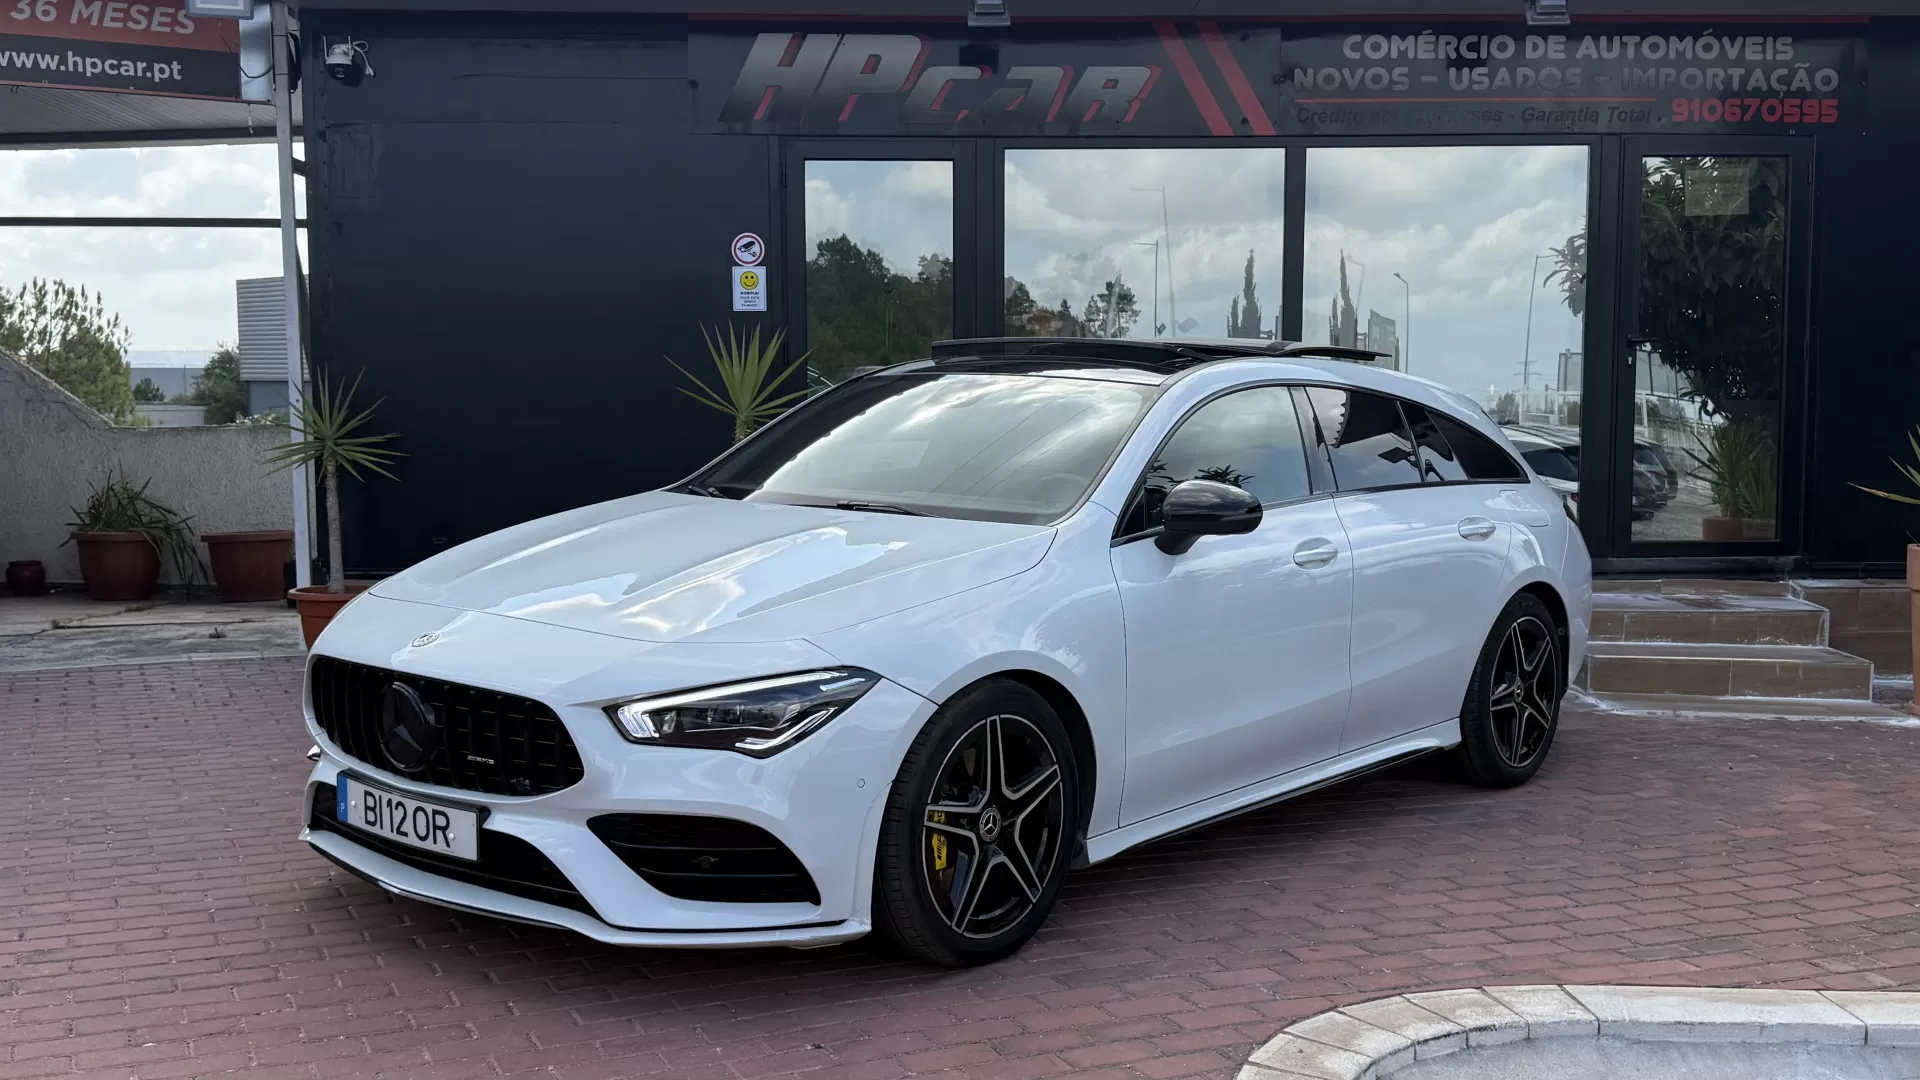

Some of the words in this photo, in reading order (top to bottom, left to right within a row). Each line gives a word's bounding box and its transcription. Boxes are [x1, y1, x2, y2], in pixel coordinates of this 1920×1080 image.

[10, 0, 57, 22] 36
[70, 0, 195, 34] MESES
[1343, 30, 1515, 59] COMÉRCIO
[1525, 35, 1567, 59] DE
[1575, 28, 1794, 60] AUTOMÓVEIS
[1294, 67, 1410, 91] NOVOS
[1449, 67, 1582, 91] USADOS
[1621, 62, 1839, 98] IMPORTAÇÃO
[1521, 105, 1600, 126] Garantia
[1607, 105, 1653, 126] Total
[1671, 98, 1838, 123] 910670595
